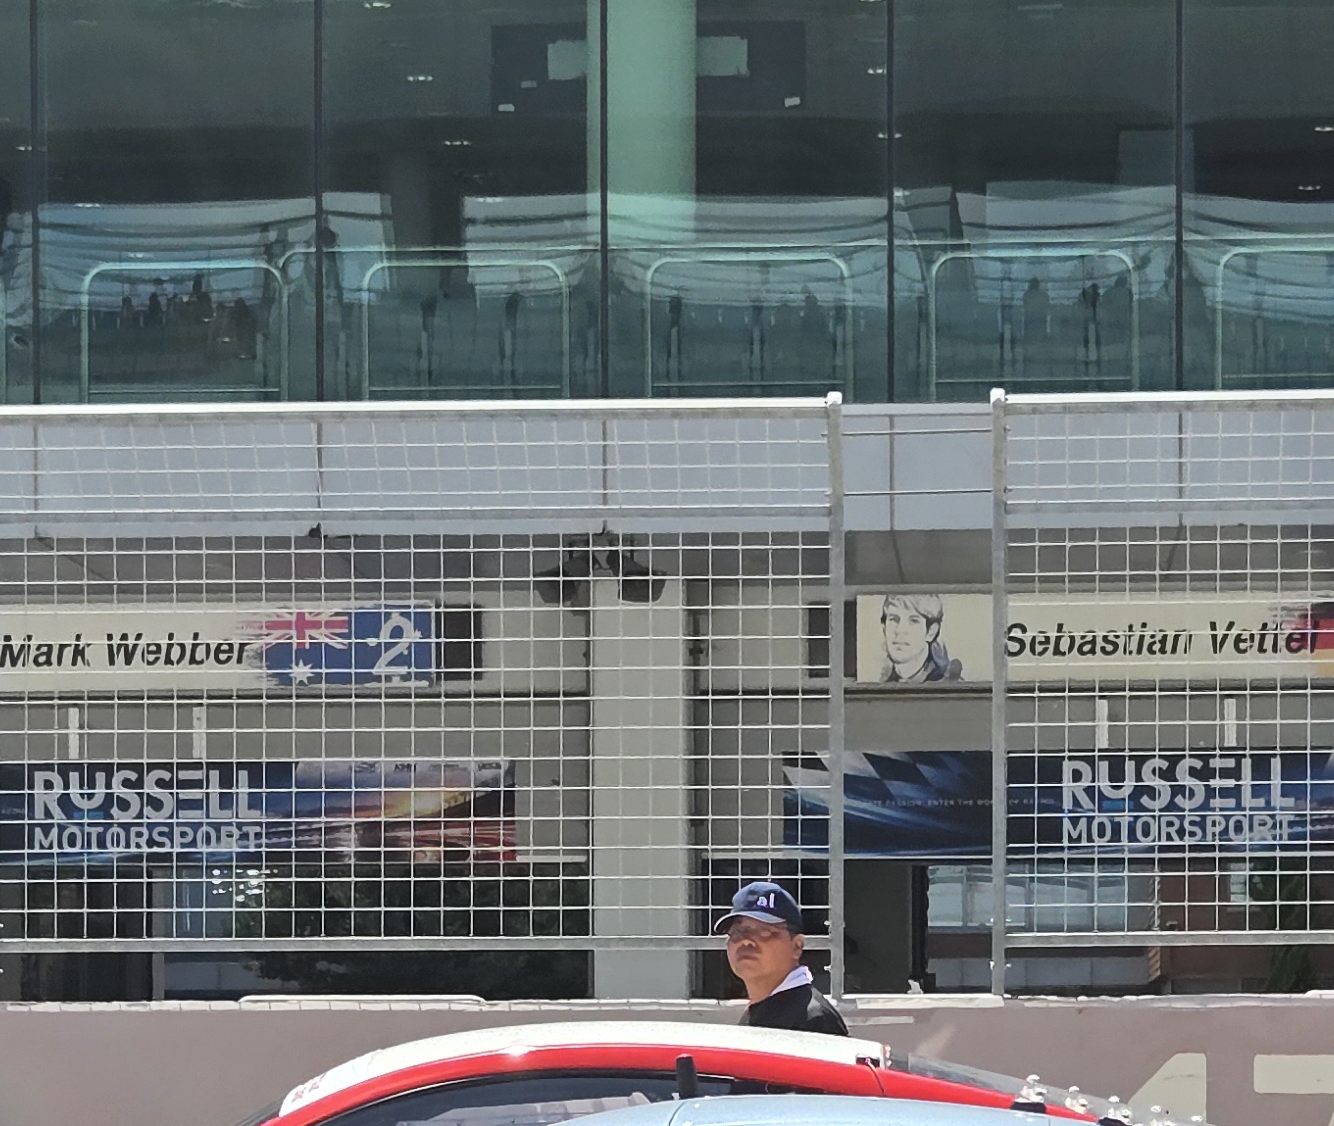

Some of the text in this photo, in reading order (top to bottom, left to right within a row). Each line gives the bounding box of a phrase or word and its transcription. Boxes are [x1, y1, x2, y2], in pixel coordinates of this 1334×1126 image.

[105, 632, 249, 667] Webber
[1005, 621, 1193, 658] Sebastian
[33, 769, 263, 820] RUSSELL
[1061, 757, 1296, 811] RUSSELL
[33, 826, 263, 851] MOTORSPORT
[1061, 815, 1296, 844] MOTORSPORT
